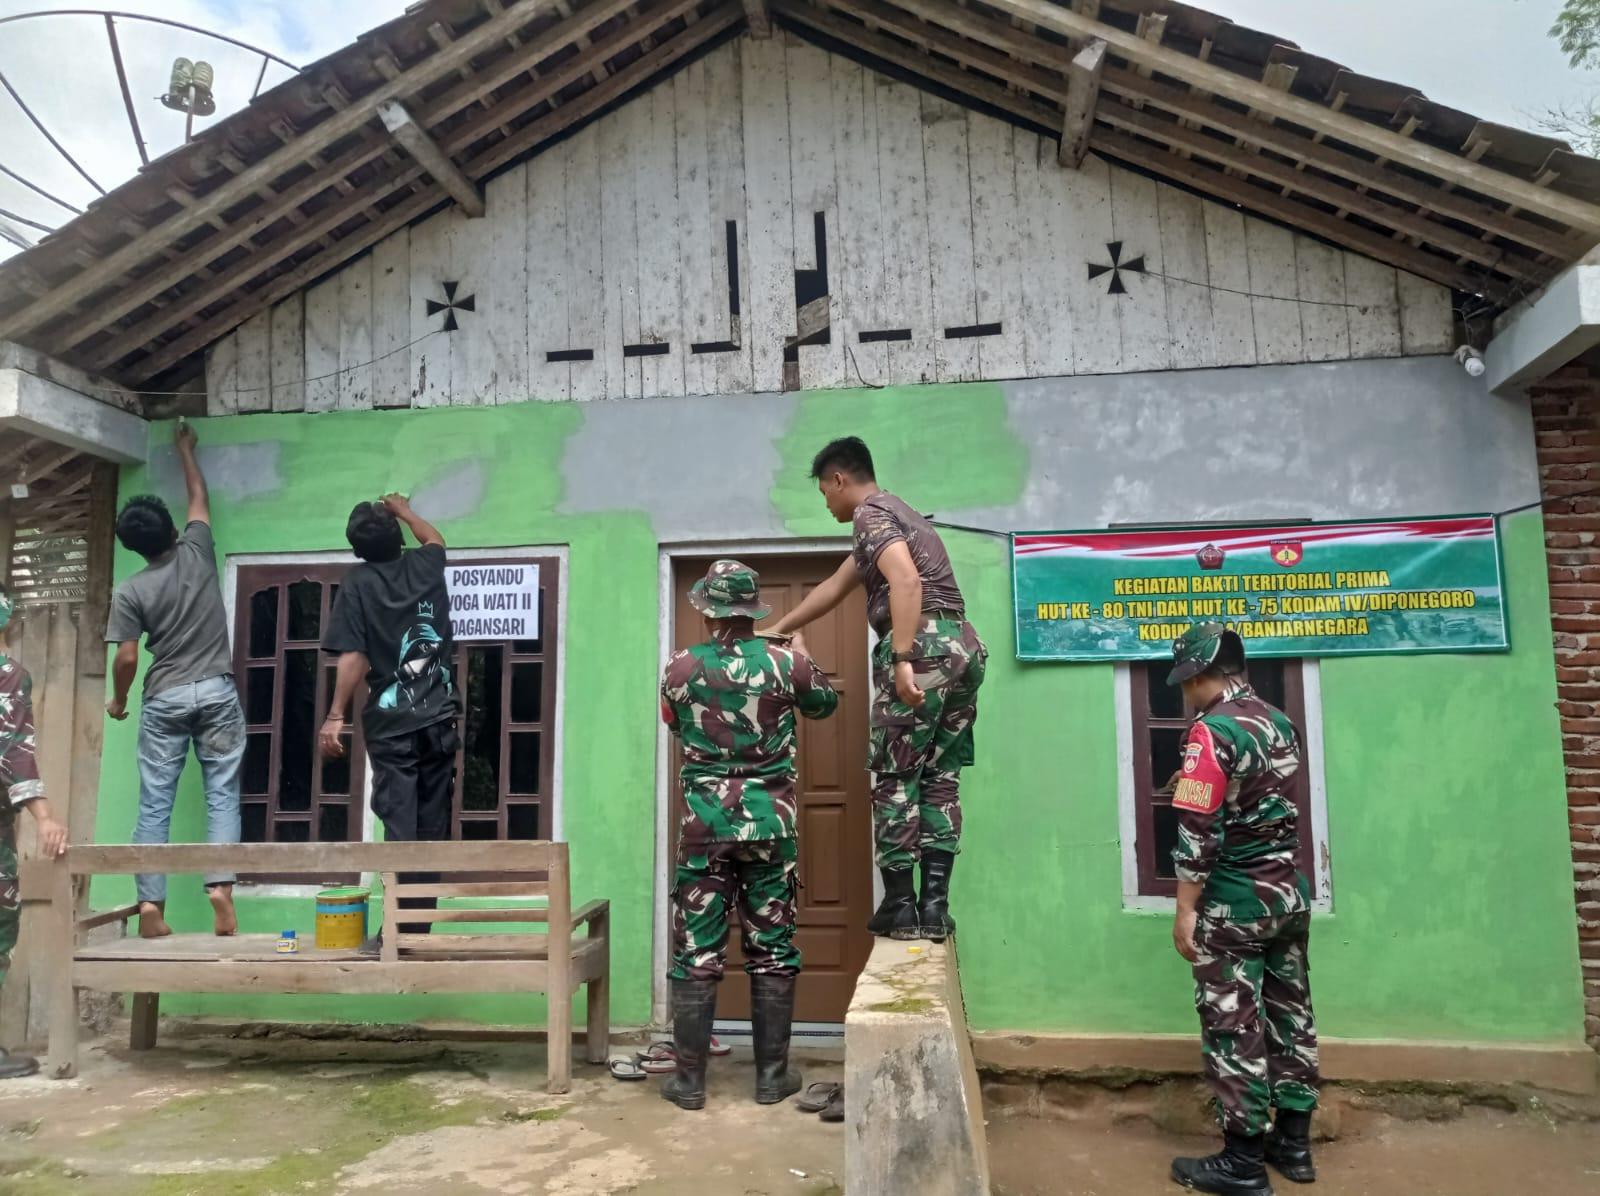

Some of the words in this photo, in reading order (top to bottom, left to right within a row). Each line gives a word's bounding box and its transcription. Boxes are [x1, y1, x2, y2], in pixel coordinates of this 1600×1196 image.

[453, 568, 524, 586] POSYANDU
[1114, 577, 1188, 595] KEGIATAN
[1192, 575, 1239, 593] BAKTI
[1242, 572, 1332, 592] TERITORIAL
[1336, 570, 1391, 589] PRIMA
[484, 593, 517, 610] WATI
[522, 593, 531, 610] II
[1038, 603, 1068, 620] HUT
[1071, 602, 1090, 619] KE
[1102, 602, 1124, 619] 80
[1126, 600, 1153, 618] TNI
[1156, 599, 1188, 617] DAN
[1192, 599, 1223, 616] HUT
[1227, 598, 1246, 615] KE
[1259, 597, 1278, 615] 75
[1281, 595, 1341, 614] KODAM
[1344, 590, 1476, 612] IV/DIPONEGORO
